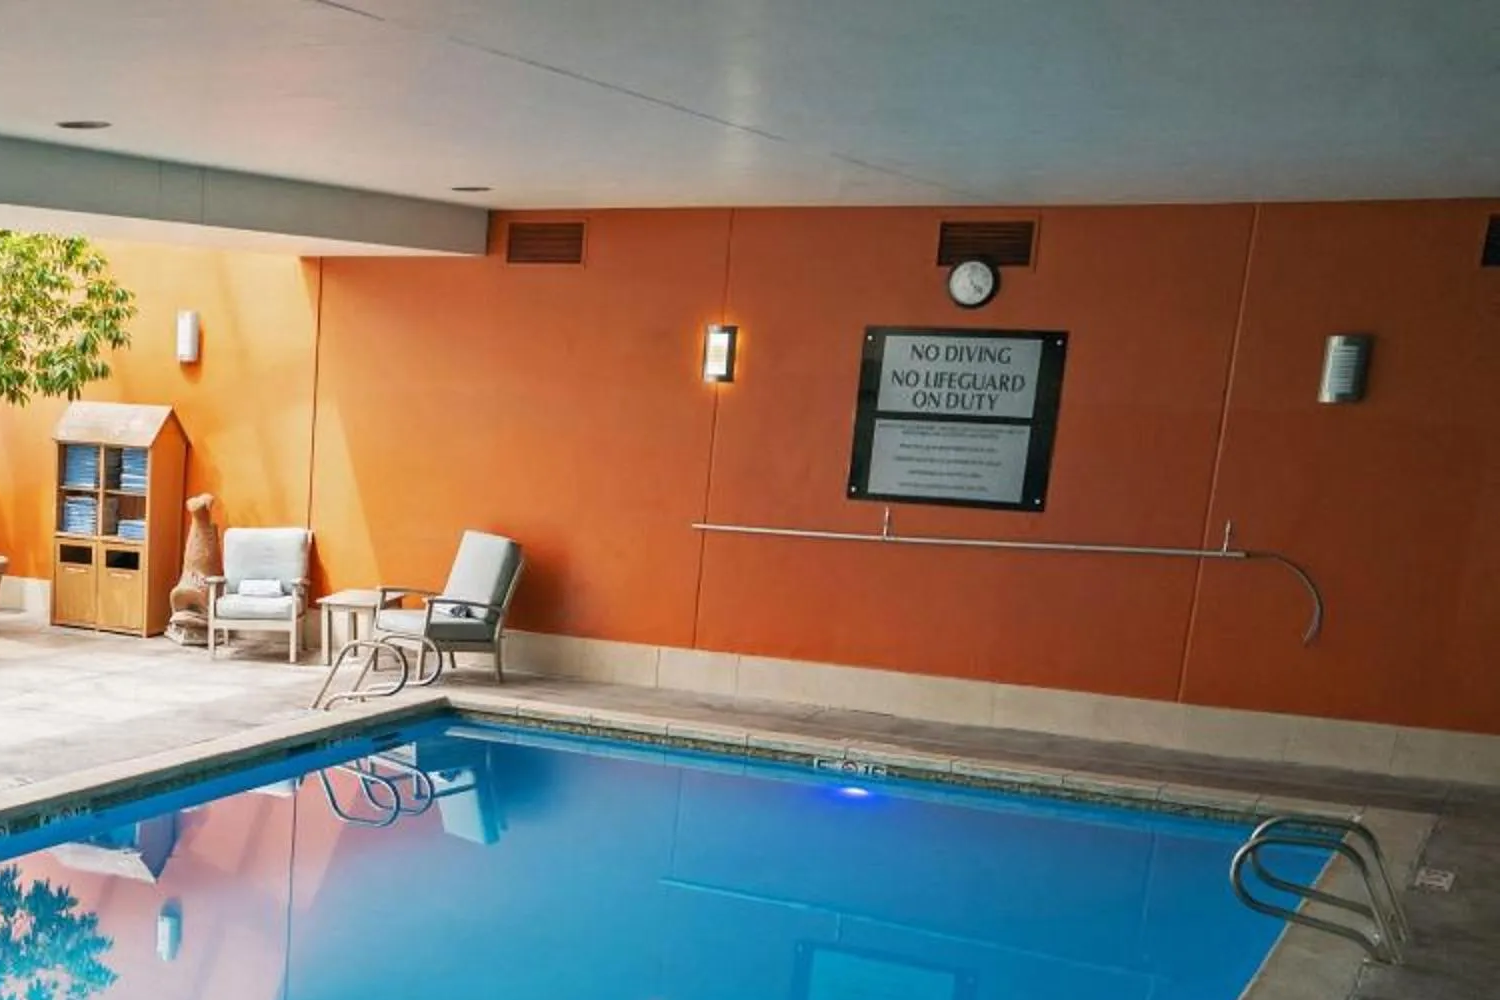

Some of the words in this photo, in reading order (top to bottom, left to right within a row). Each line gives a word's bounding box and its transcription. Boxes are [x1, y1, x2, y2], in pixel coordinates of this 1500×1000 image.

[909, 343, 940, 362] NO
[944, 345, 1013, 365] DIVING
[891, 369, 920, 388] NO
[924, 371, 1026, 393] LIFEGUARD
[911, 390, 942, 409] ON
[945, 392, 1000, 411] DUTY
